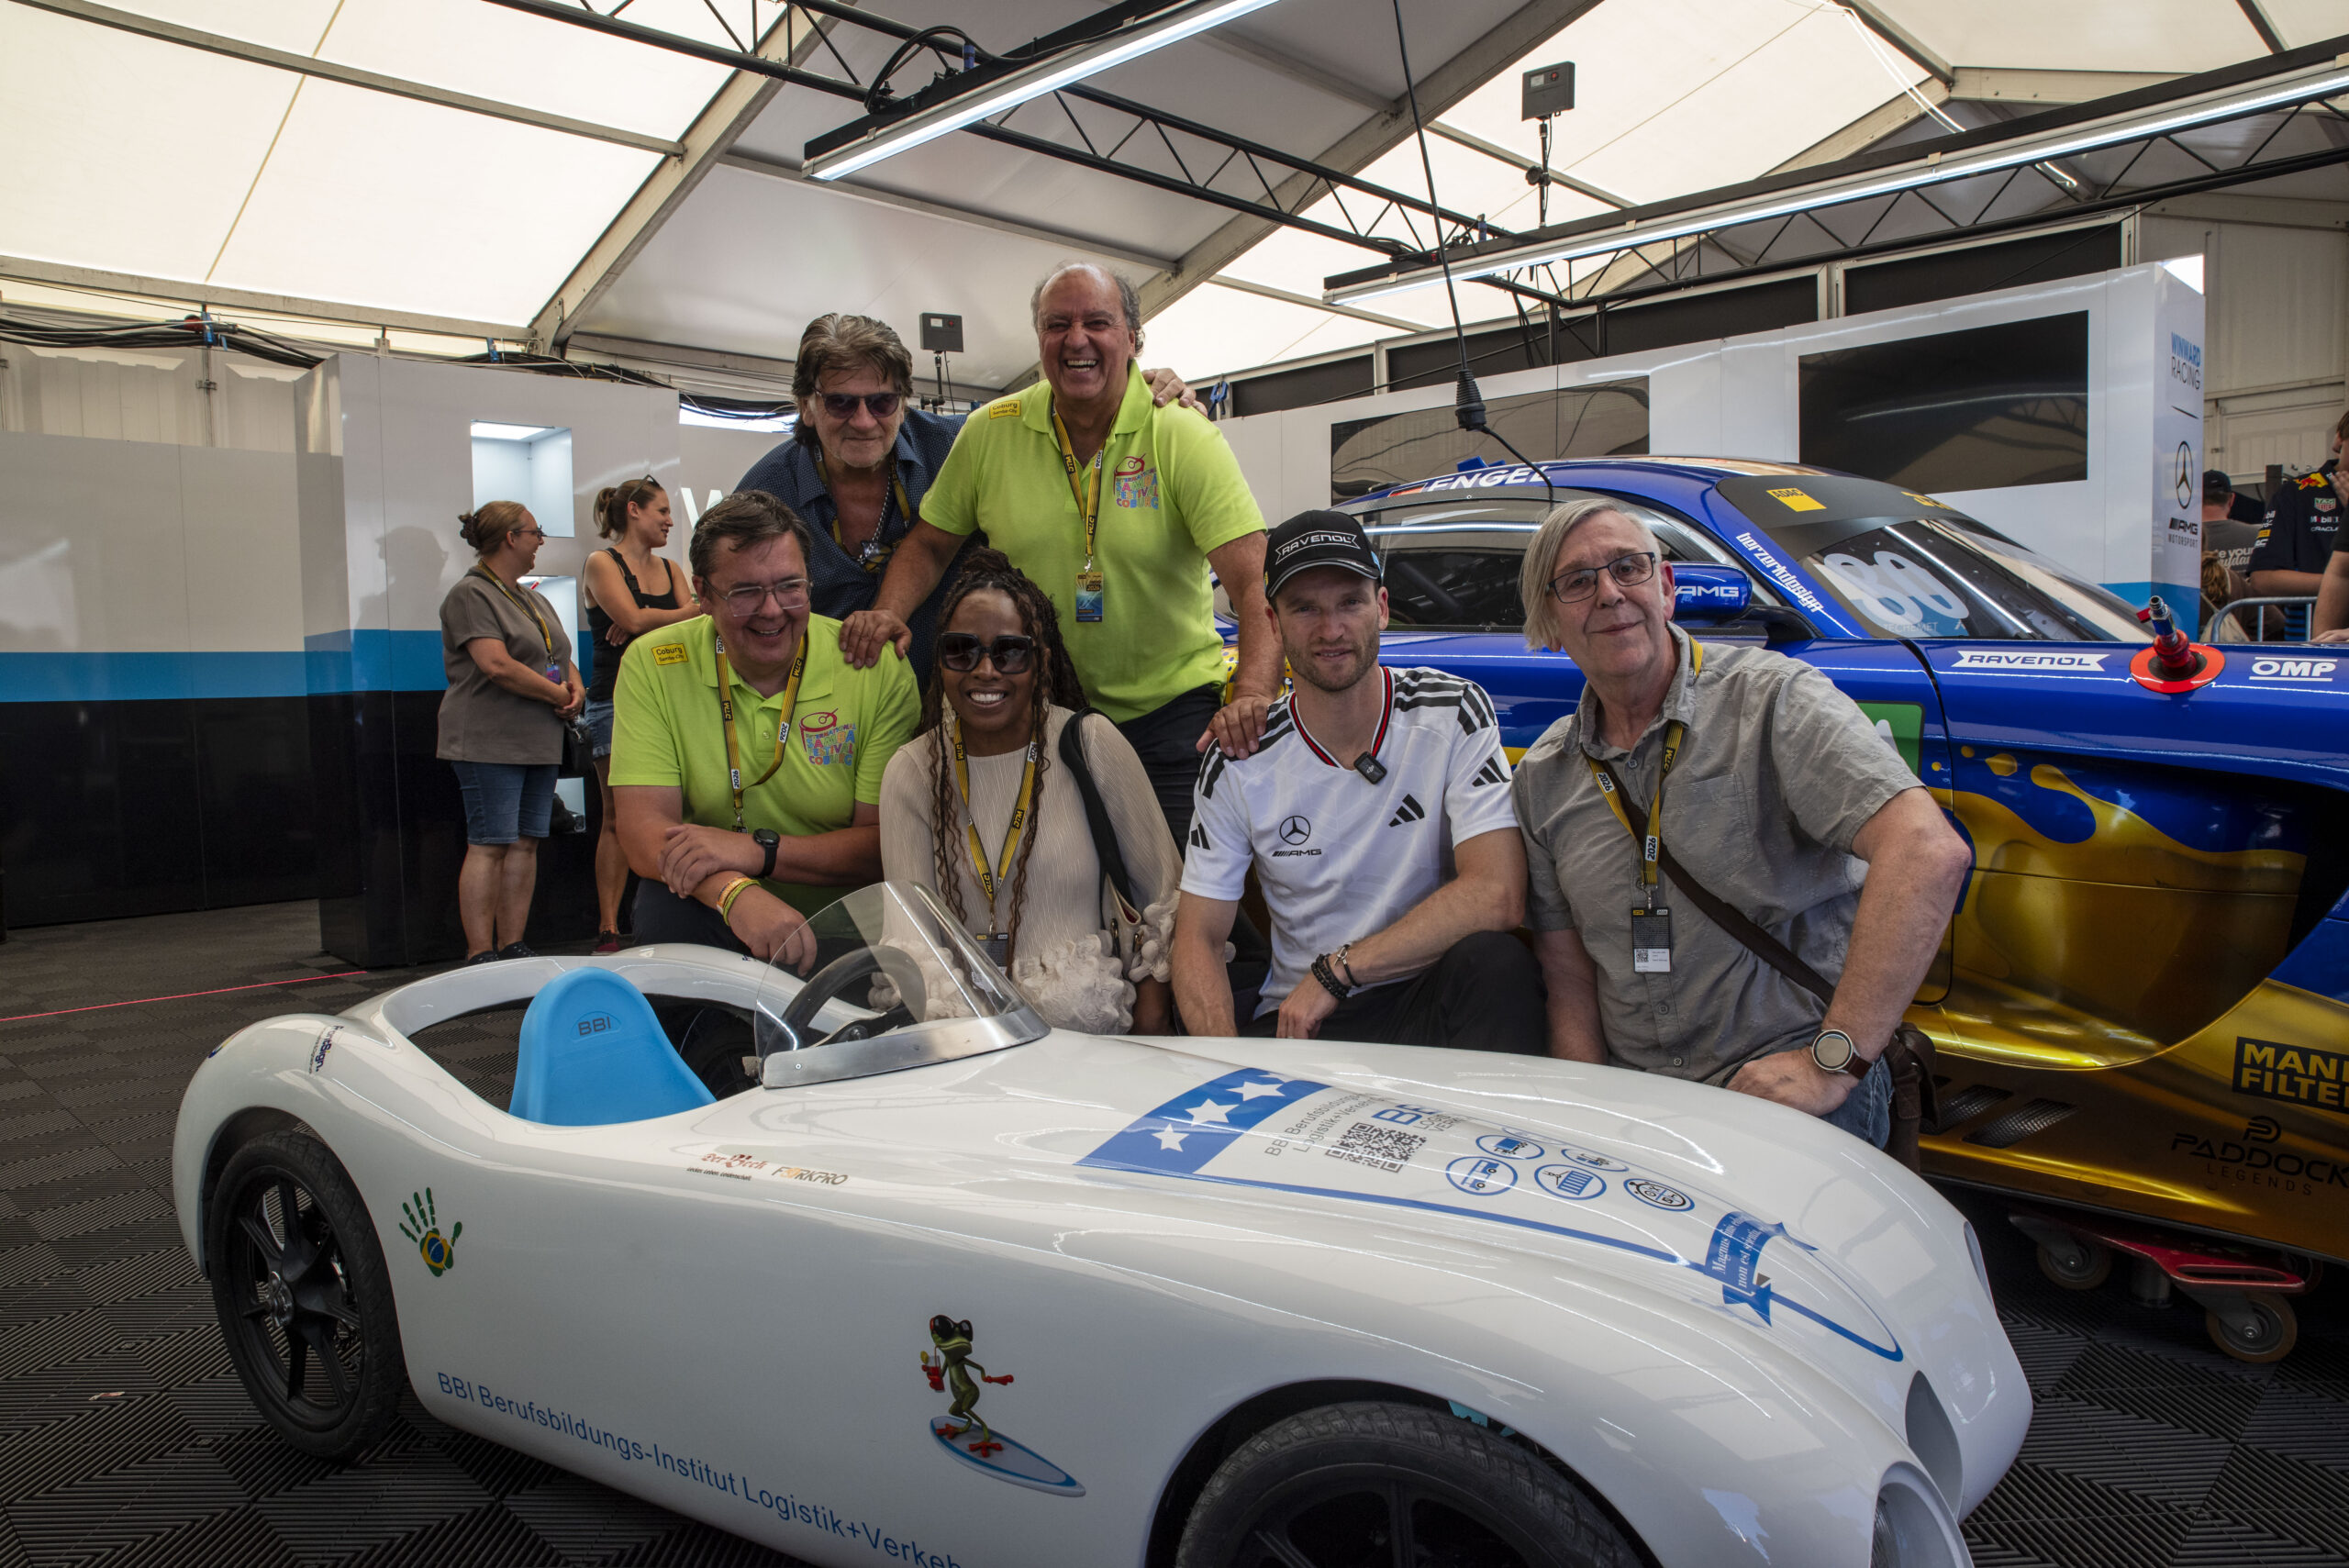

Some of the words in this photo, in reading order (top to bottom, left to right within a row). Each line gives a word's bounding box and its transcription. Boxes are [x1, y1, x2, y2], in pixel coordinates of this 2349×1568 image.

[2171, 356, 2200, 390] RACING
[1116, 473, 1158, 491] SAMBA
[1427, 465, 1551, 492] ENGEL
[1116, 485, 1158, 499] FESTIVAL
[1772, 489, 1804, 497] ADAC
[1116, 496, 1158, 509] COBURG
[2175, 518, 2198, 535] AMG
[1282, 534, 1352, 556] RAVENOL
[1675, 586, 1739, 597] AMG
[656, 647, 683, 656] Coburg
[1967, 655, 2091, 666] RAVENOL
[2252, 661, 2336, 677] OMP
[780, 723, 788, 741] 2026
[807, 729, 855, 748] SAMBA
[807, 743, 853, 756] FESTIVAL
[809, 753, 852, 765] COBURG
[1664, 749, 1674, 771] DTM
[1598, 773, 1611, 791] 2026
[1014, 809, 1023, 828] DTM
[1285, 849, 1321, 857] AMG
[1647, 837, 1656, 860] 2026
[983, 874, 993, 894] DTM
[578, 1017, 611, 1036] BBI
[2171, 1132, 2349, 1188] PADDOCK
[2207, 1162, 2312, 1195] LEGENDS
[1712, 1237, 1731, 1274] Magnus
[1740, 1250, 1752, 1265] est
[1739, 1266, 1748, 1288] non
[438, 1372, 475, 1402] BBI
[478, 1385, 738, 1496] Berufsbildungs-Institut
